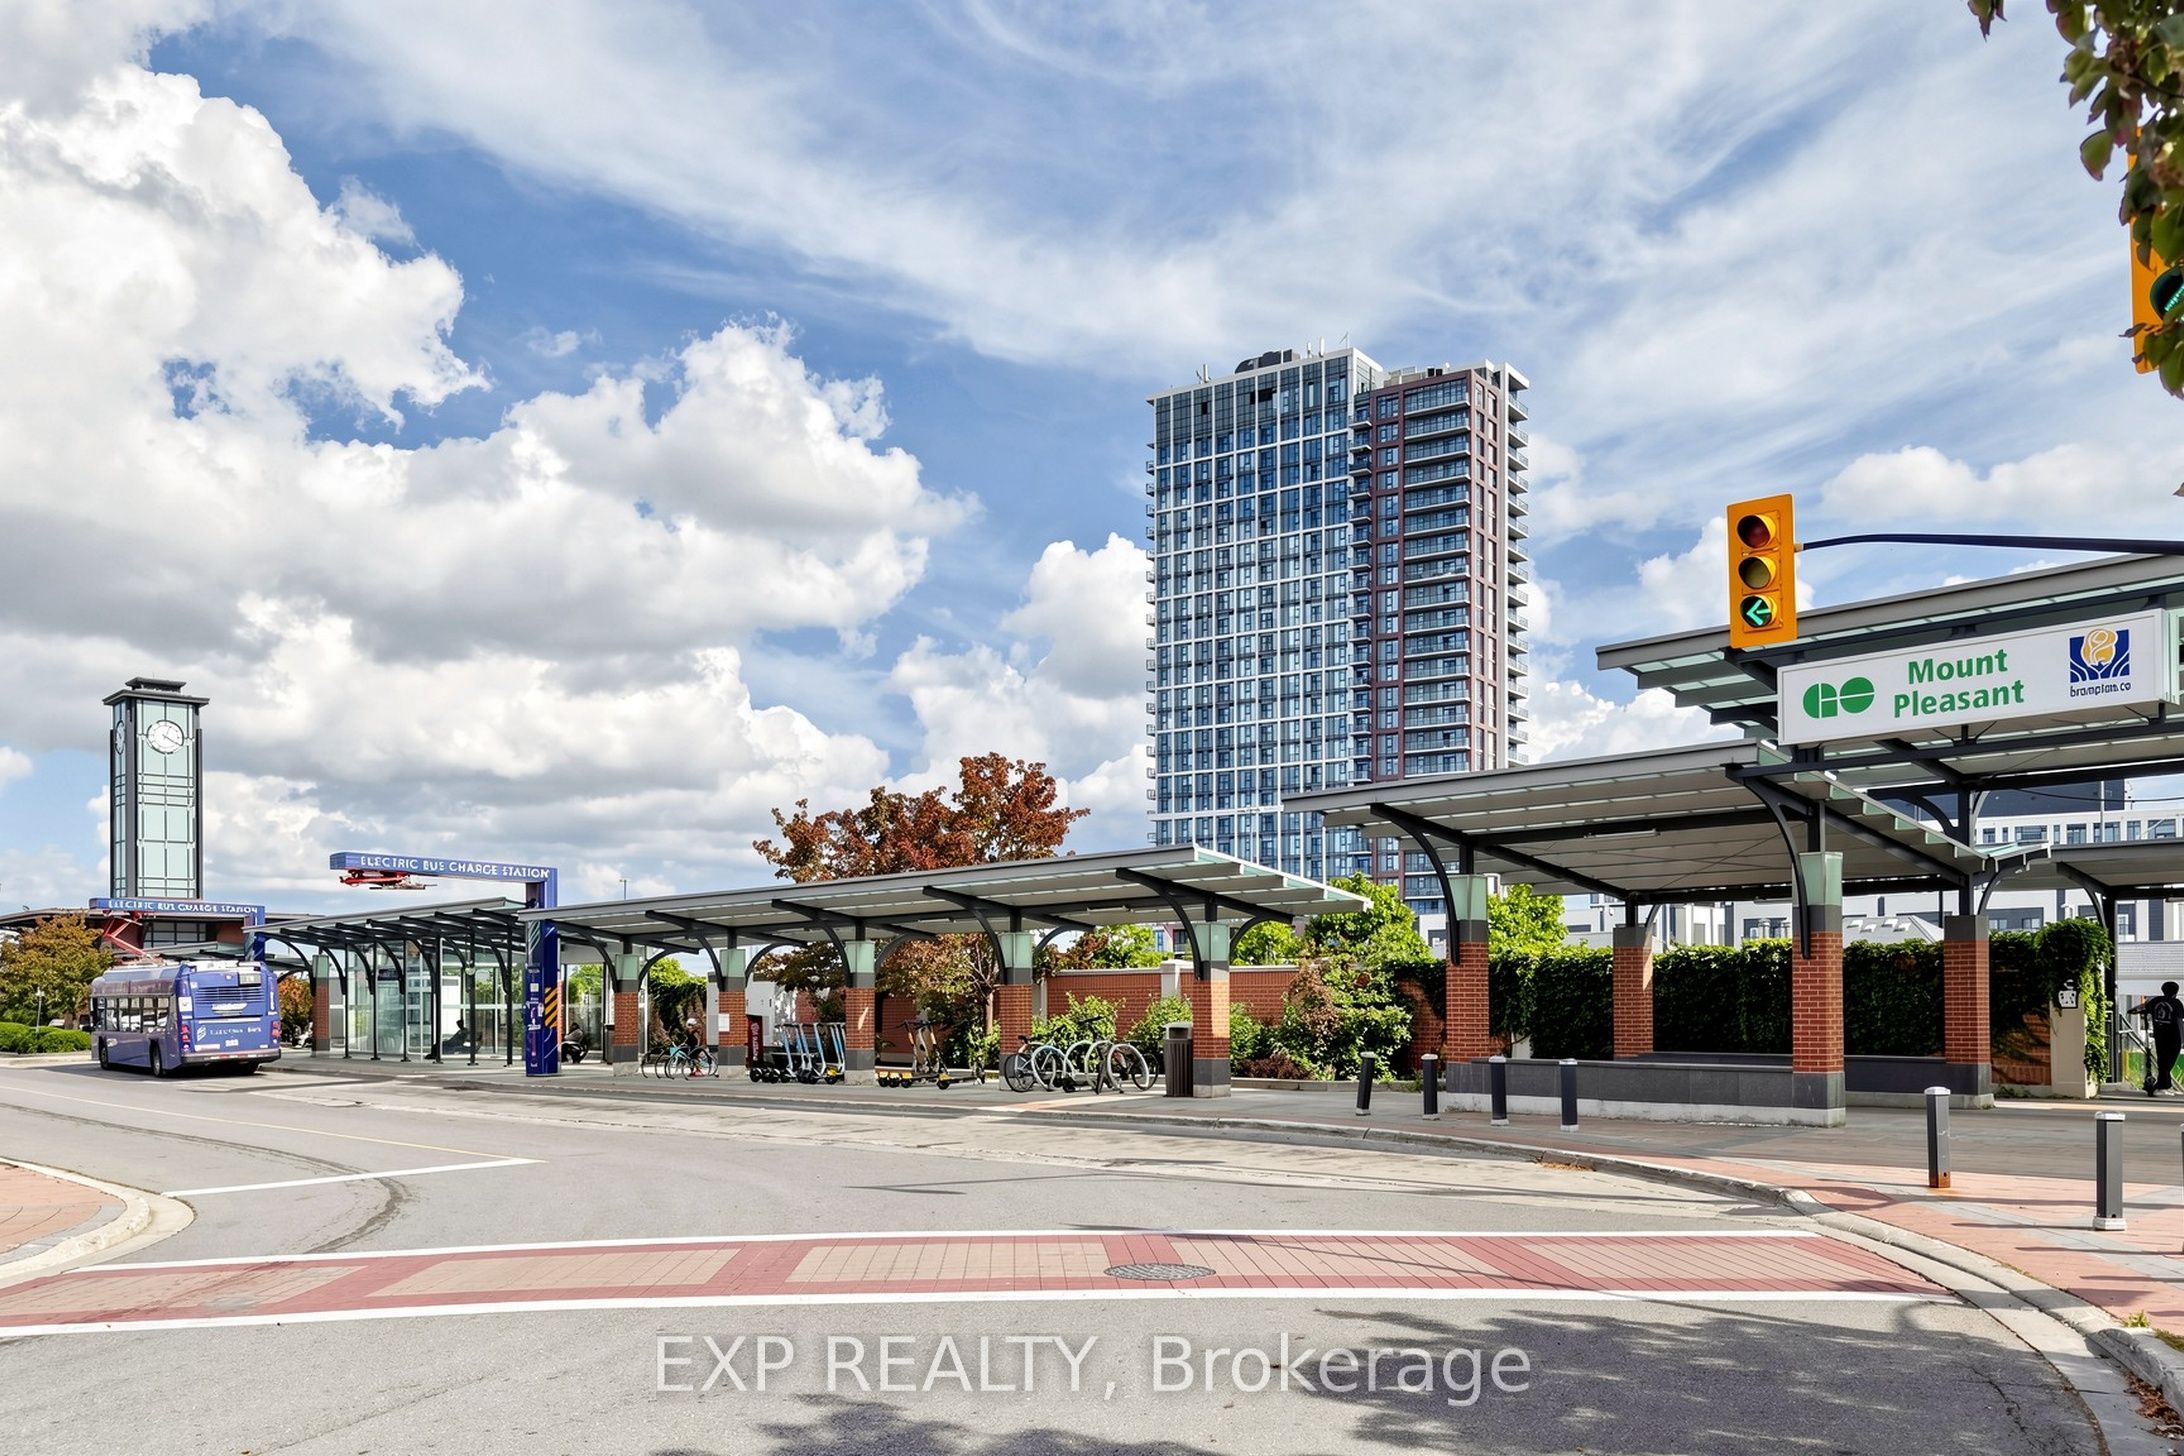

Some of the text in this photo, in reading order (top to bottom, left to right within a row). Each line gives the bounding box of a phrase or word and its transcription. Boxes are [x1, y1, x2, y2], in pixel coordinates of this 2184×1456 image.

[1908, 649, 2008, 685] Mount
[1893, 679, 2024, 718] Pleasant
[360, 855, 550, 878] ELECTRIC BUS CHARGE STATION
